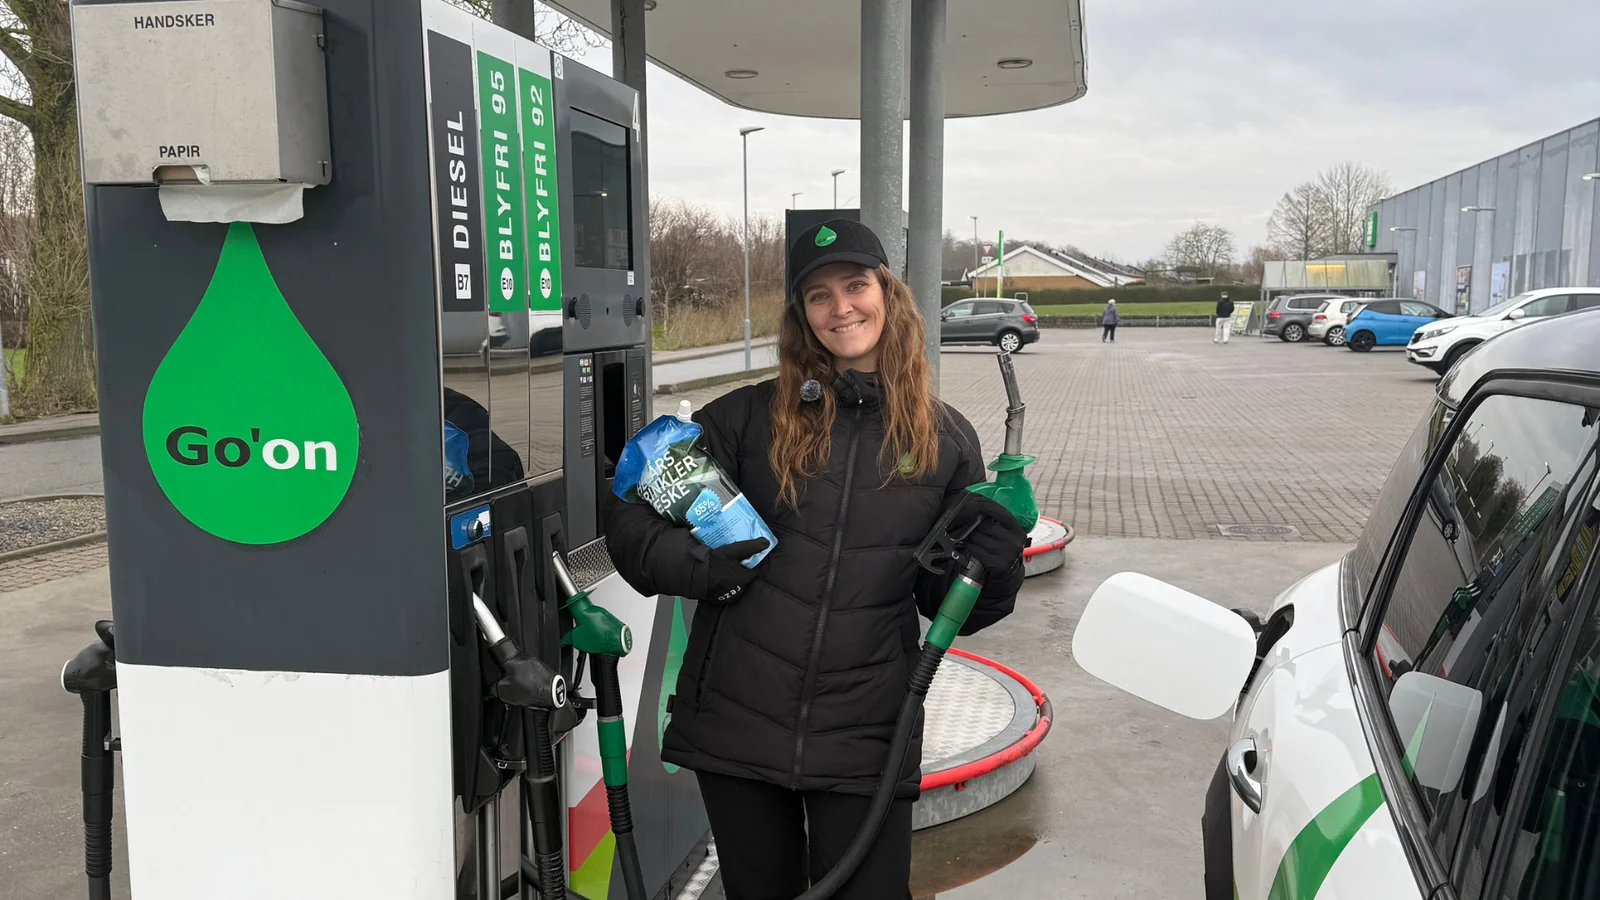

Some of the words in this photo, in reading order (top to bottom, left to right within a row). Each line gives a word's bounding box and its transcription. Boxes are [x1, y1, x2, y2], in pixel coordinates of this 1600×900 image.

[134, 13, 215, 29] HANDSKER
[490, 71, 507, 115] 95
[531, 85, 545, 126] 92
[632, 92, 640, 143] 4
[159, 145, 201, 158] PAPIR
[447, 111, 470, 249] DIESEL
[494, 130, 514, 260] BLYFRI
[533, 140, 551, 262] BLYFRI
[457, 273, 469, 290] B7
[502, 278, 513, 290] E10
[166, 425, 338, 472] Go'on
[638, 455, 698, 504] RINKLER
[694, 498, 715, 516] 65%
